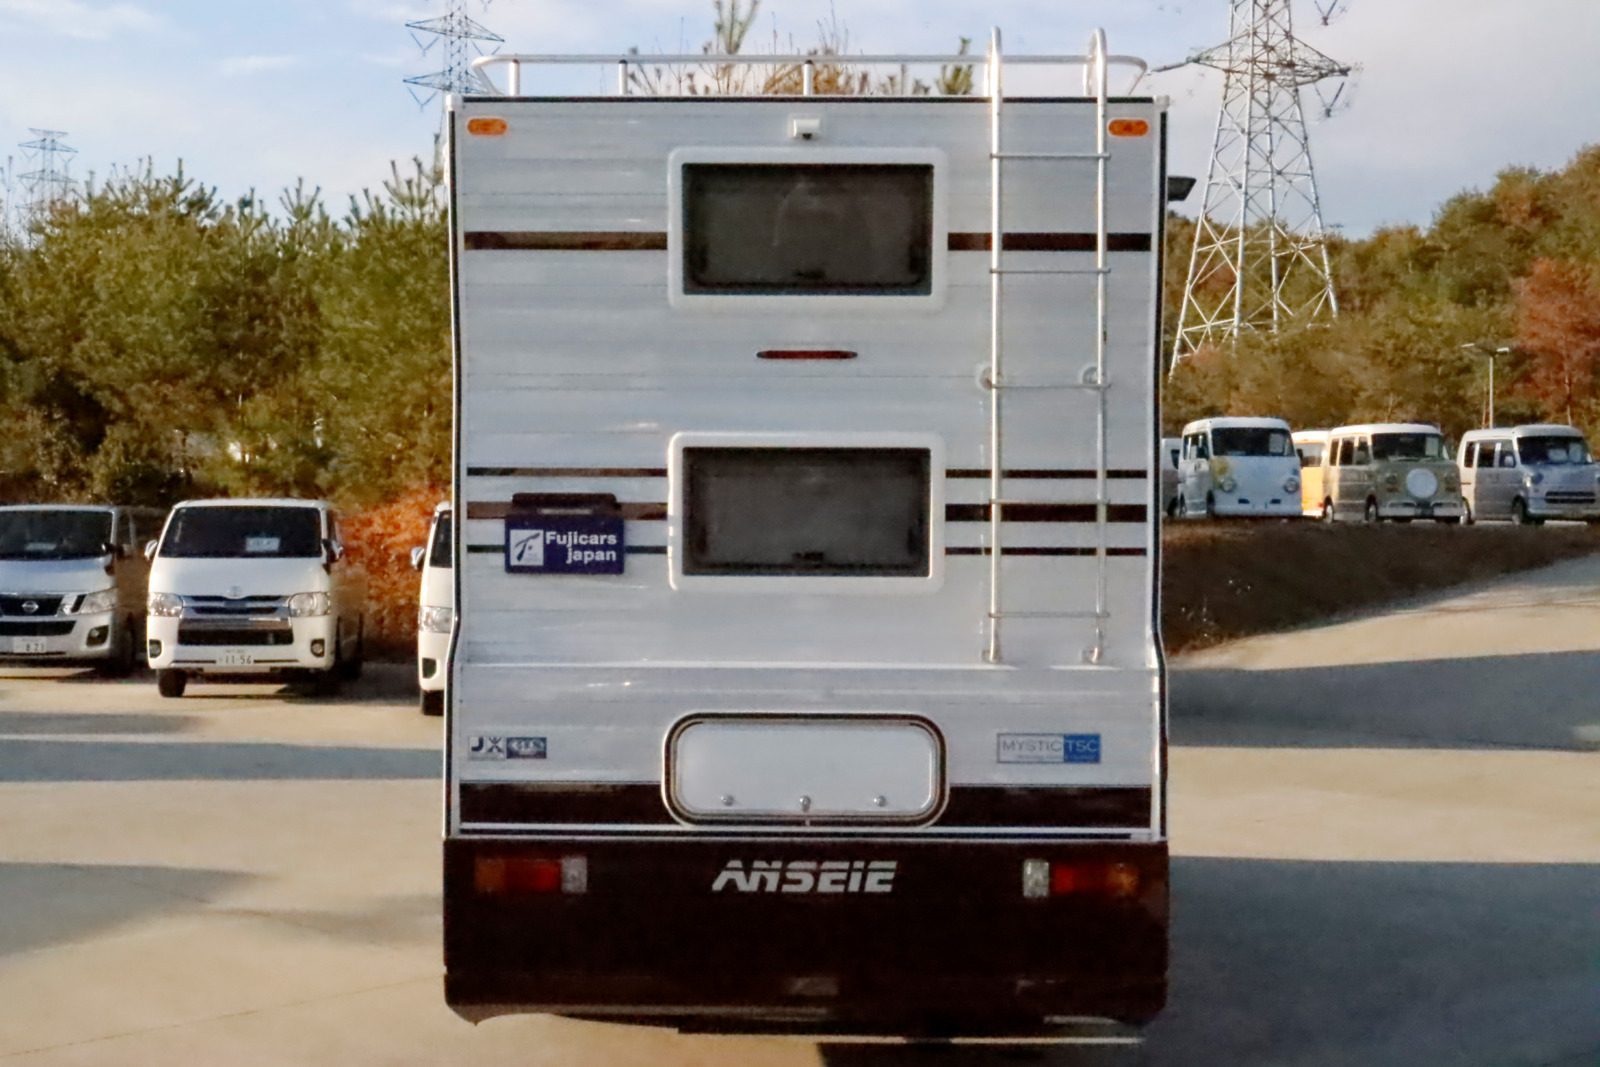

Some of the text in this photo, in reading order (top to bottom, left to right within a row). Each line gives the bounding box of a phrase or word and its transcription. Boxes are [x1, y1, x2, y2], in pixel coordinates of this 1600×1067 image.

[545, 531, 617, 548] Fujicars
[1002, 740, 1099, 753] MYSTIC TSC
[711, 859, 898, 893] ANSEIE
